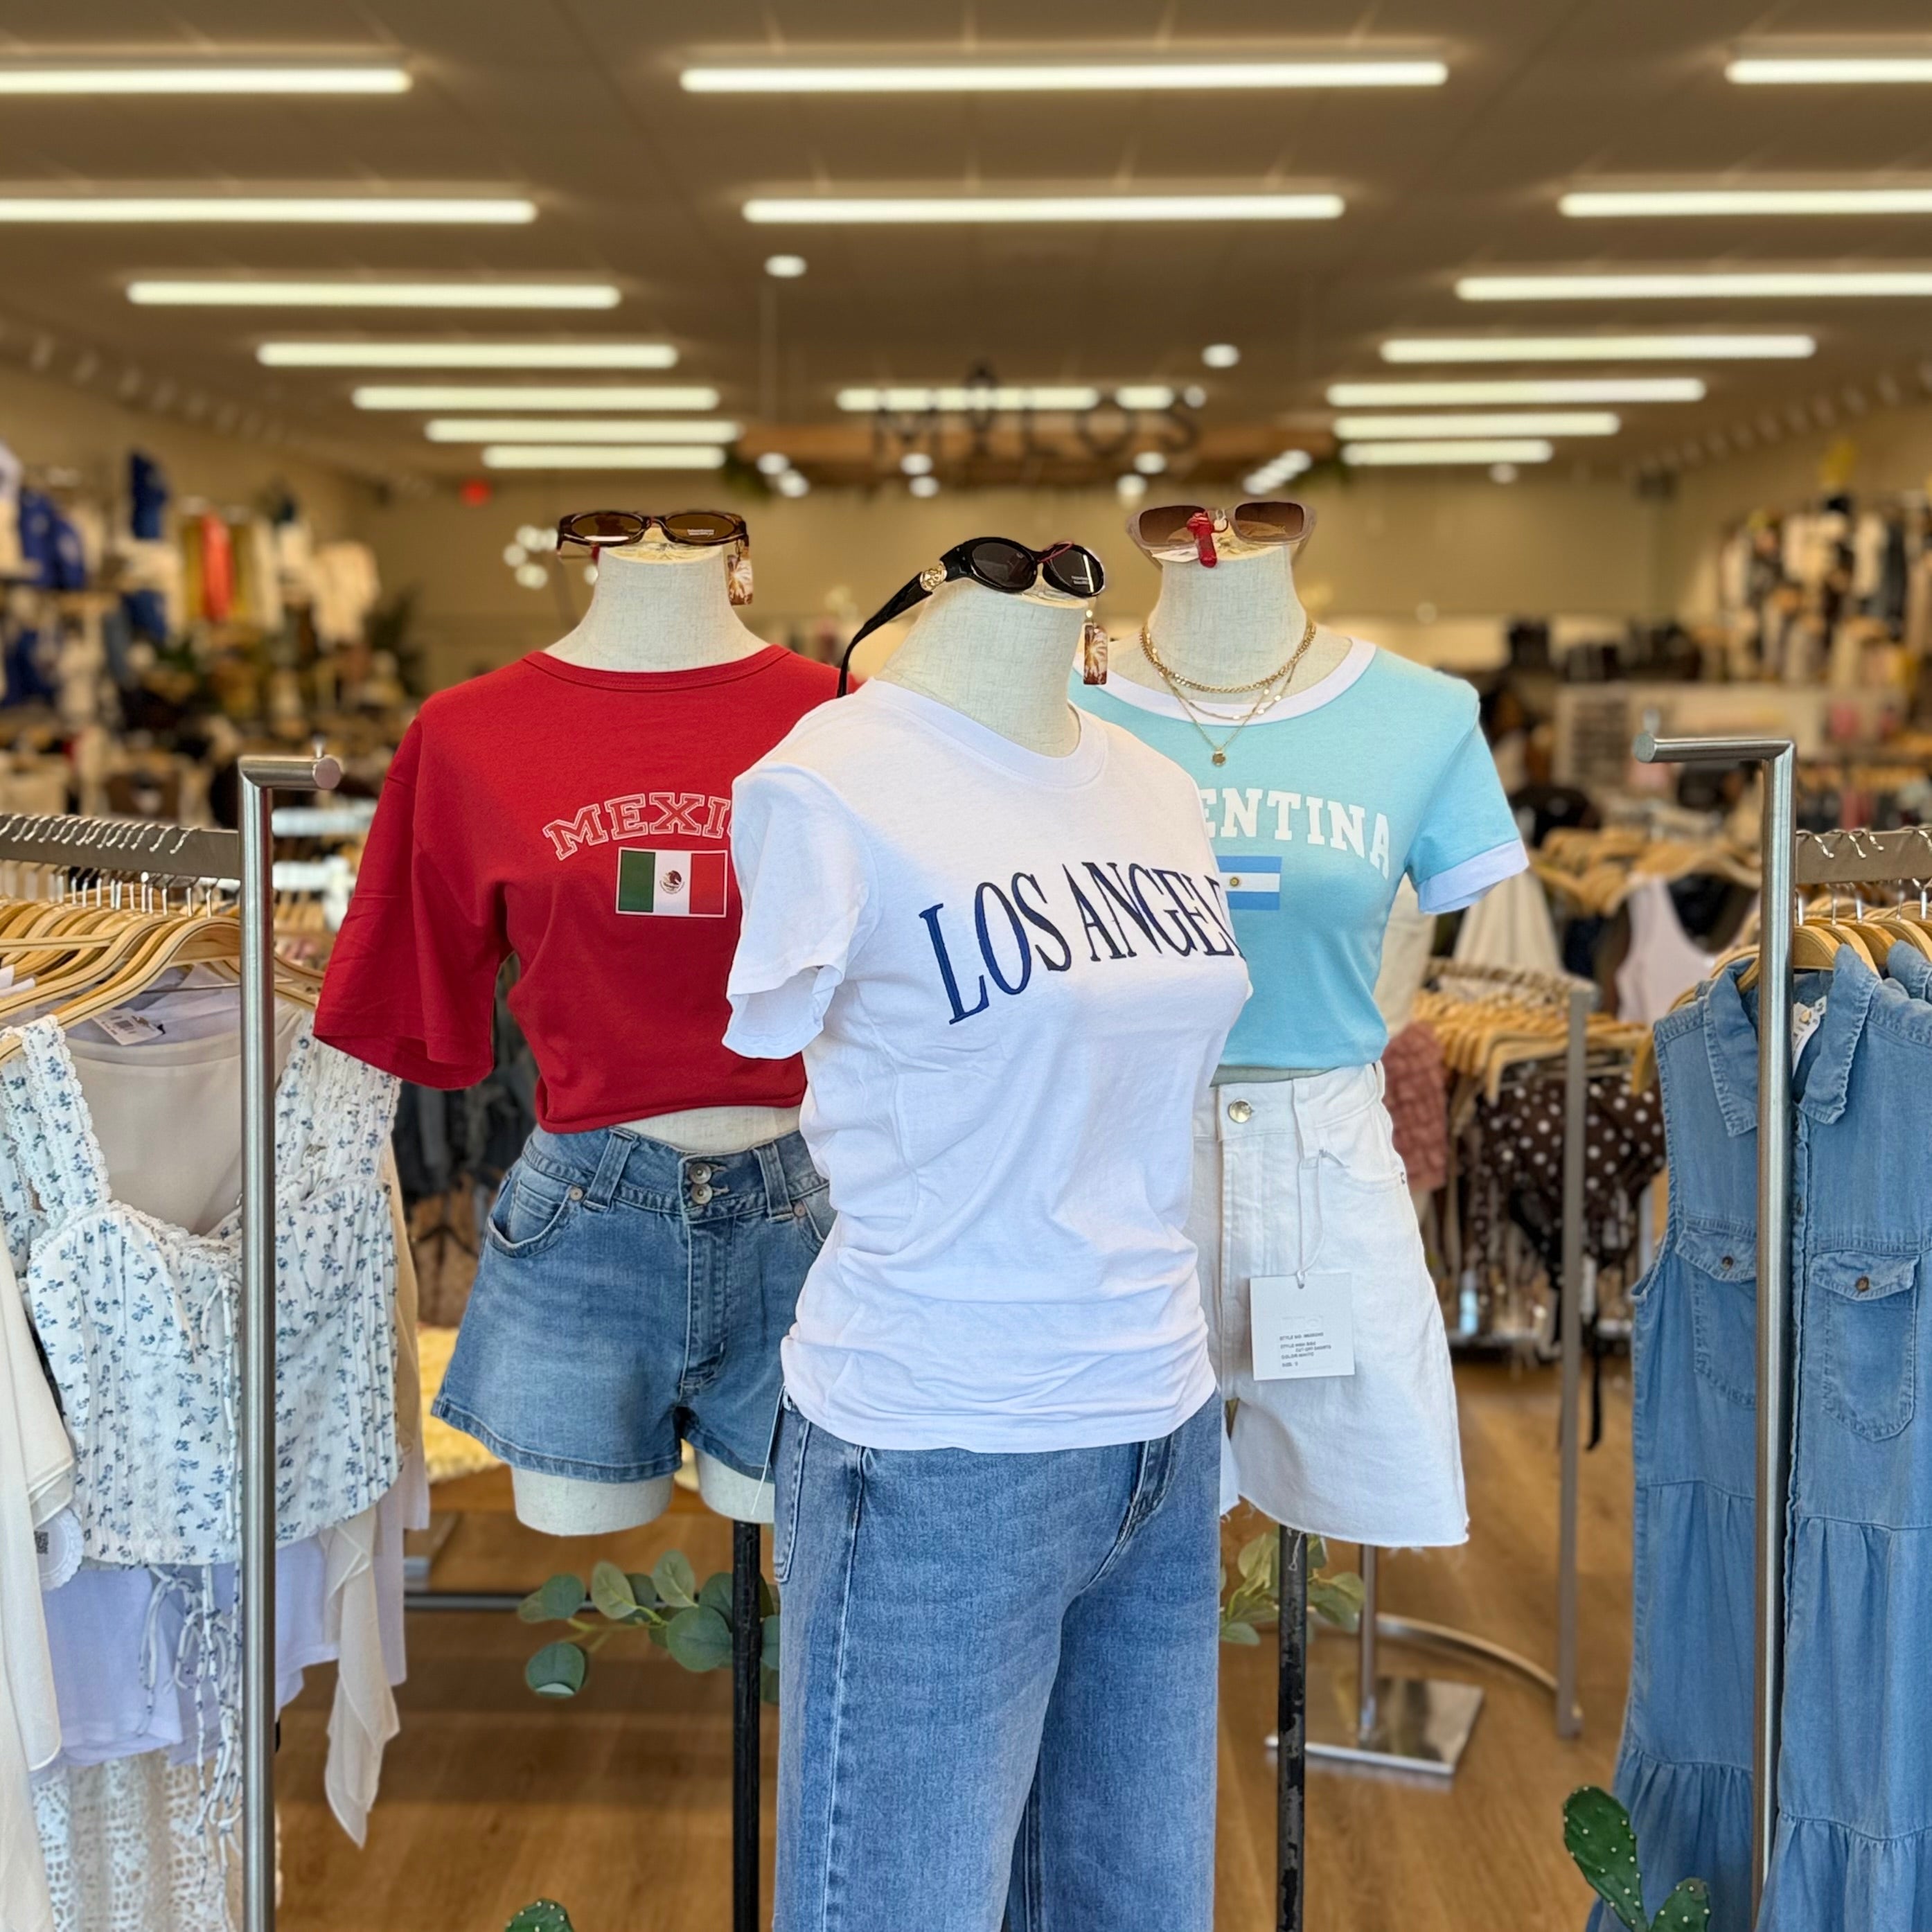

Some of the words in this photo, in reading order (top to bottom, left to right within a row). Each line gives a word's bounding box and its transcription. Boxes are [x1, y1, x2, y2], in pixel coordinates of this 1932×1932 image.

[542, 792, 732, 861] MEXI
[919, 872, 1072, 1025] LOS
[1062, 862, 1246, 962] ANGEL
